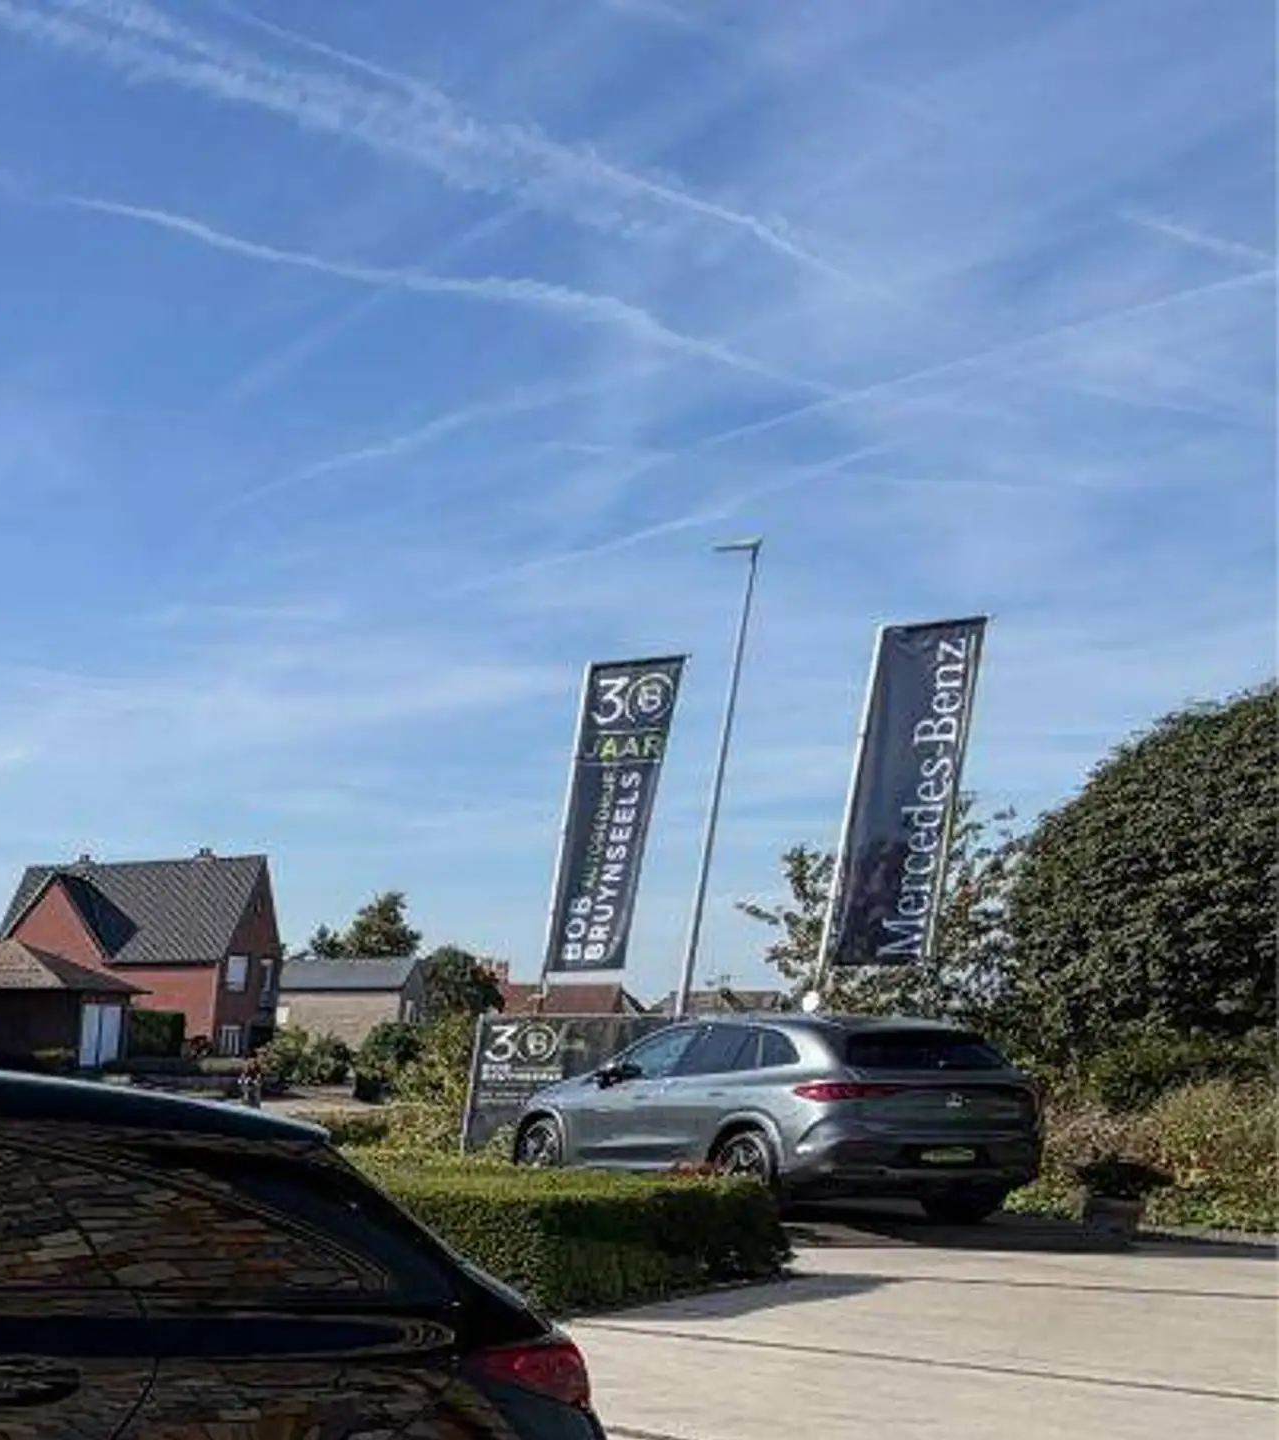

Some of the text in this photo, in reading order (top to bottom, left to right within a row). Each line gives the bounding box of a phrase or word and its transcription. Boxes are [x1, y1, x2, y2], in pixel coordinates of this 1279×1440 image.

[584, 736, 662, 759] JAAR
[876, 637, 967, 957] Mercedes-Benz
[562, 895, 592, 961] BOB
[584, 771, 642, 961] BRUYNSEELS
